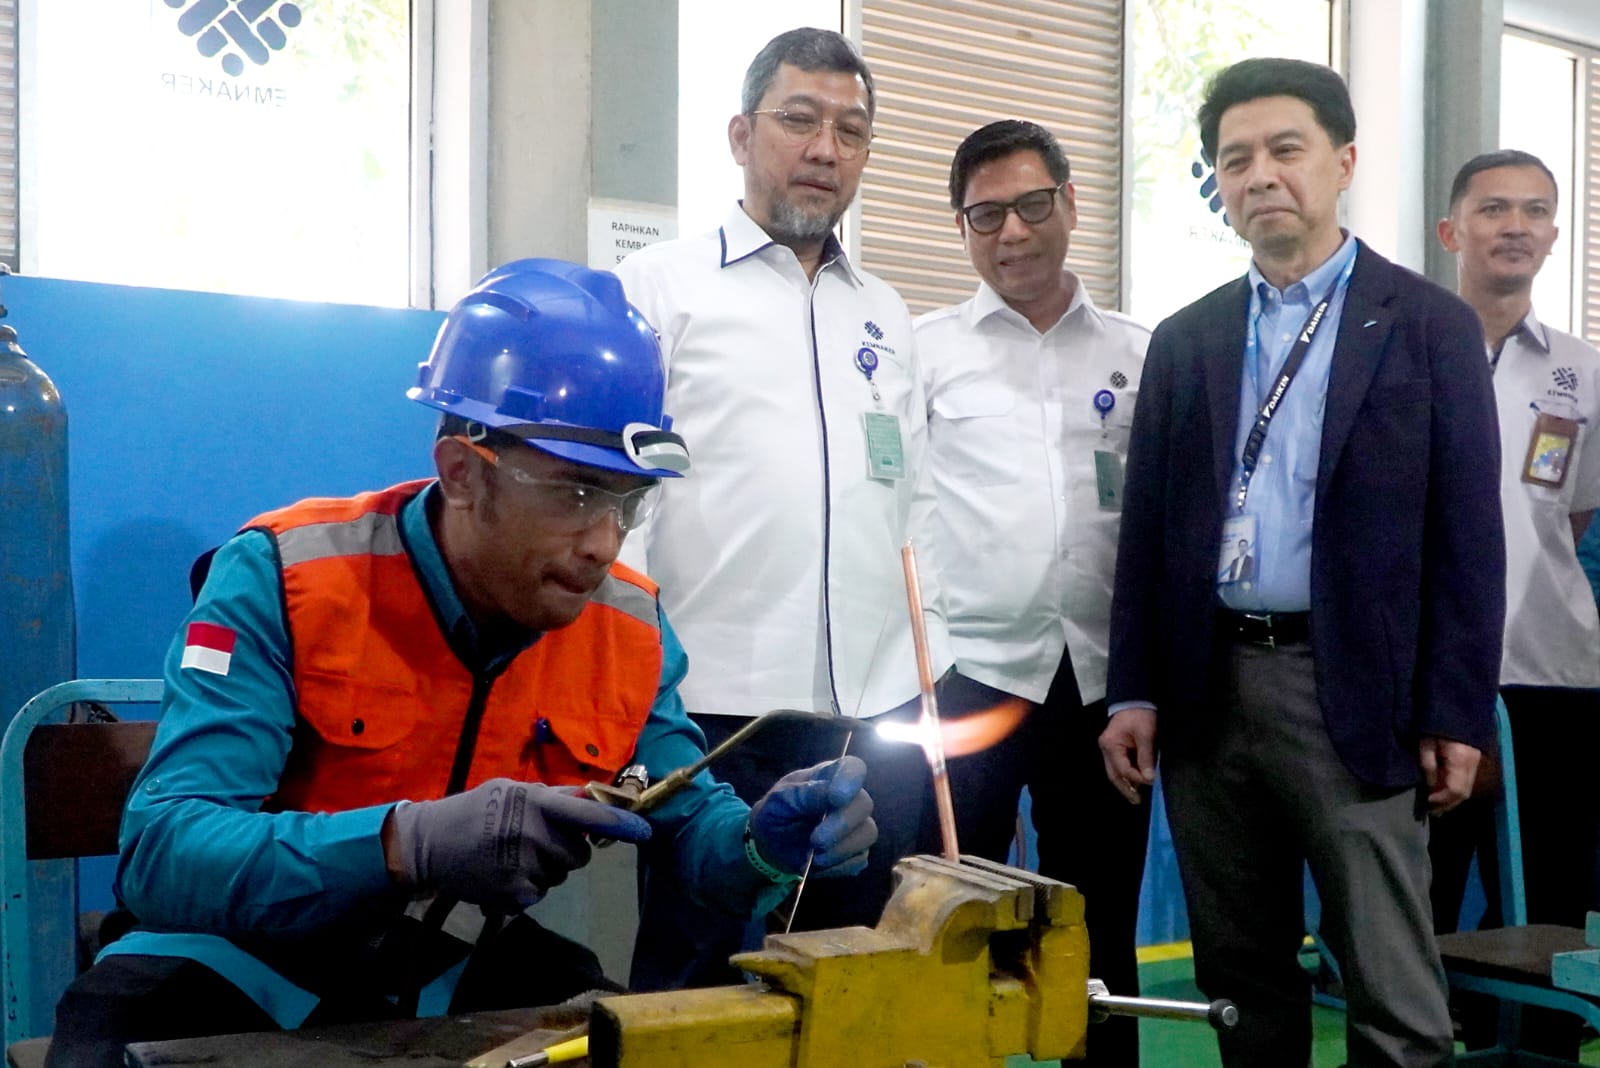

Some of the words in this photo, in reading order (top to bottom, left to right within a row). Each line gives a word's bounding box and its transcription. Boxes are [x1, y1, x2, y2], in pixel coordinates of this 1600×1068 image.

[611, 221, 660, 236] RAPIHKAN
[615, 239, 651, 250] KEMBA
[1307, 302, 1328, 334] DAIKIN
[1268, 375, 1290, 409] DAIKIN
